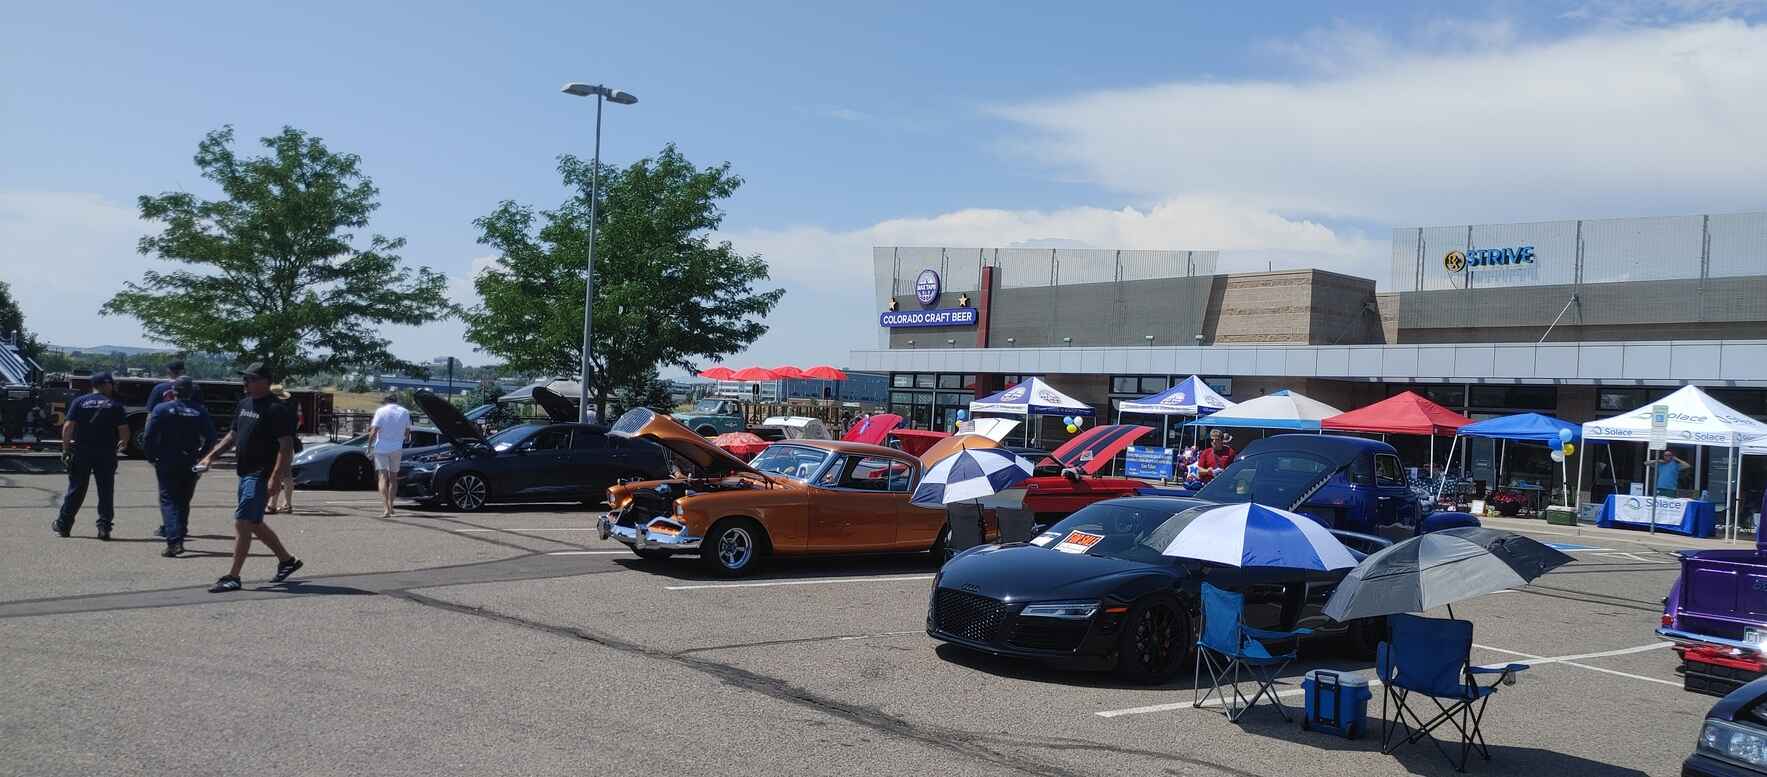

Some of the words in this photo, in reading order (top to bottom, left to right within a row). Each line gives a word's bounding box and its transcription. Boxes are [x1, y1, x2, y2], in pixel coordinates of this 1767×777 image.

[1467, 246, 1534, 266] STRIVE
[883, 314, 924, 324] COLORADO
[925, 312, 951, 323] CRAFT
[952, 311, 972, 322] BEER
[1667, 412, 1708, 422] olace
[1604, 428, 1633, 436] Solace
[1695, 432, 1726, 441] Solace
